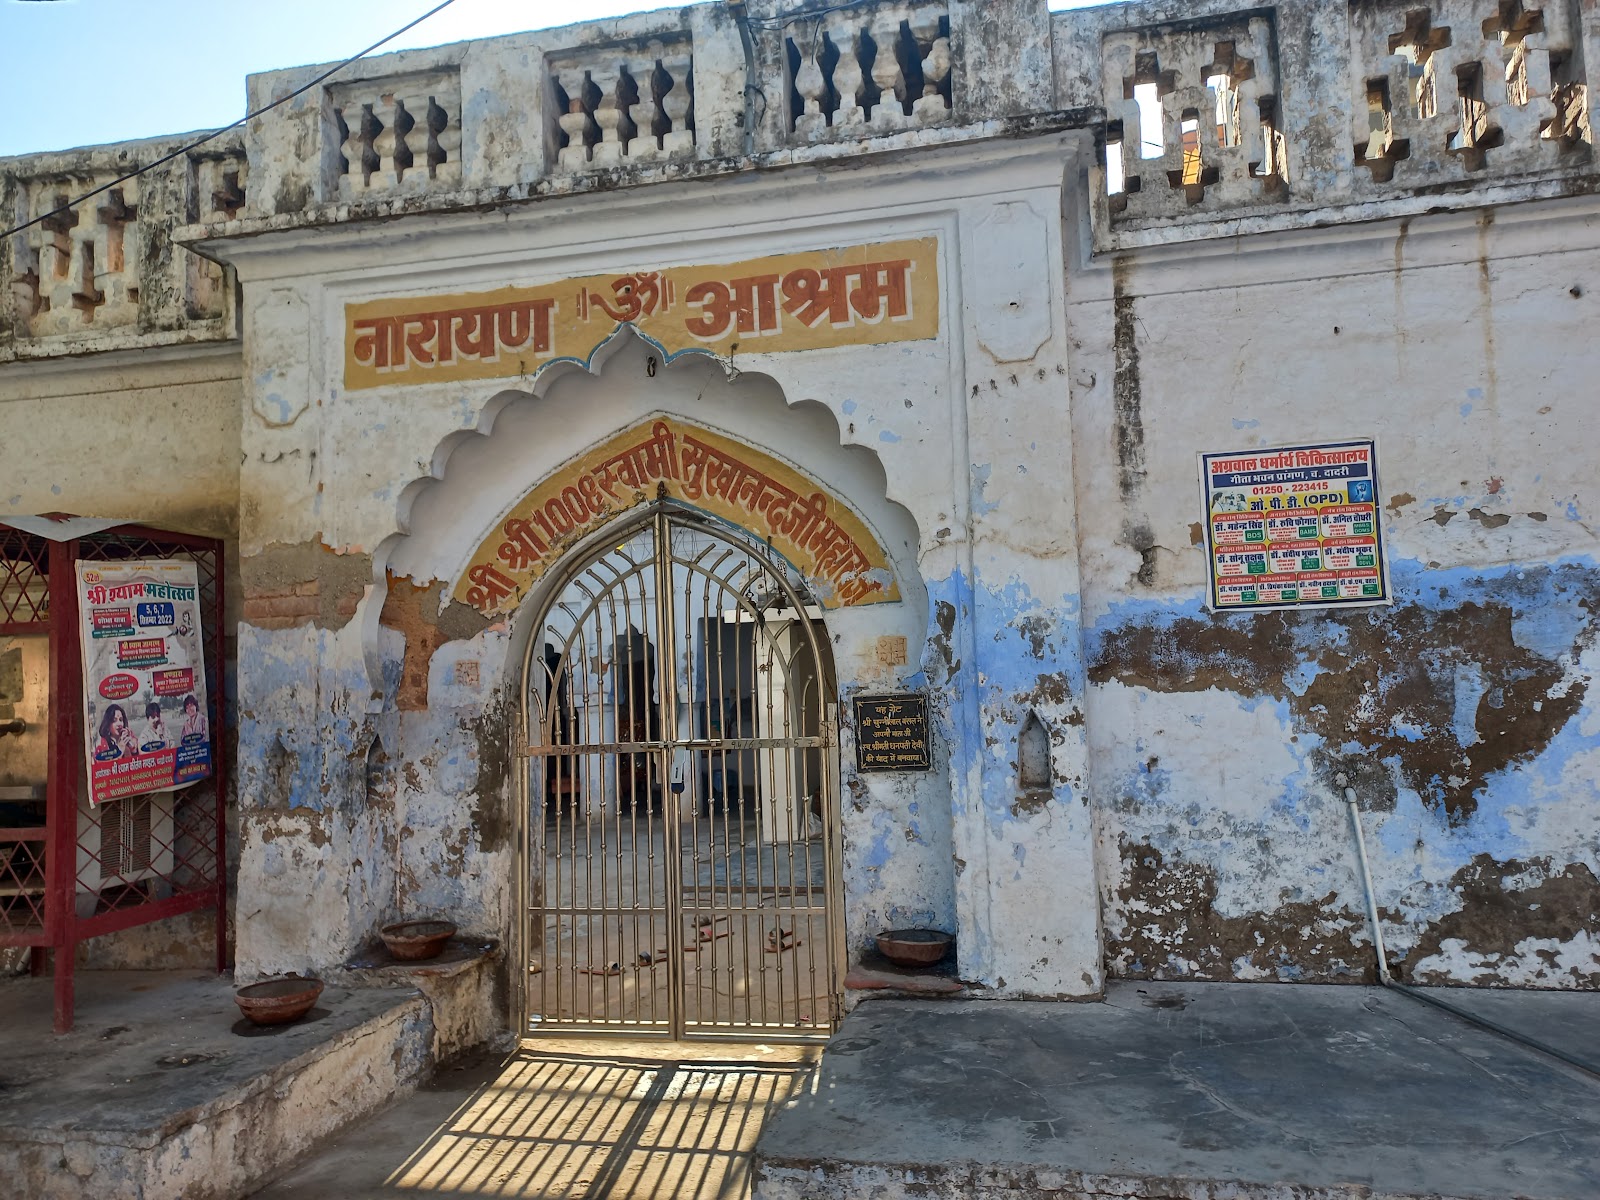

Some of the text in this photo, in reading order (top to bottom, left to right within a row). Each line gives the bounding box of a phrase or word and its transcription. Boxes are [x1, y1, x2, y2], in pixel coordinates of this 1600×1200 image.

[353, 298, 557, 371] नारायण
[684, 259, 912, 338] आश्रम
[1211, 449, 1368, 474] अग्रवाल धर्मार्थ चिकित्सालय
[1230, 475, 1252, 484] गीता
[1253, 473, 1274, 482] भवन
[1324, 466, 1349, 477] दादरी
[1252, 485, 1283, 495] 01250
[1291, 481, 1328, 492] 223415
[1250, 493, 1343, 511] ओ. पी. डी. (OPD)
[466, 562, 518, 611] श्री
[497, 518, 548, 570] श्री
[532, 474, 604, 538] 1008
[590, 421, 680, 504] स्वामी
[1300, 528, 1317, 536] BAMS
[87, 580, 196, 605] श्री श्याम महोत्सव
[158, 614, 173, 624] 2022
[862, 716, 872, 726] श्री
